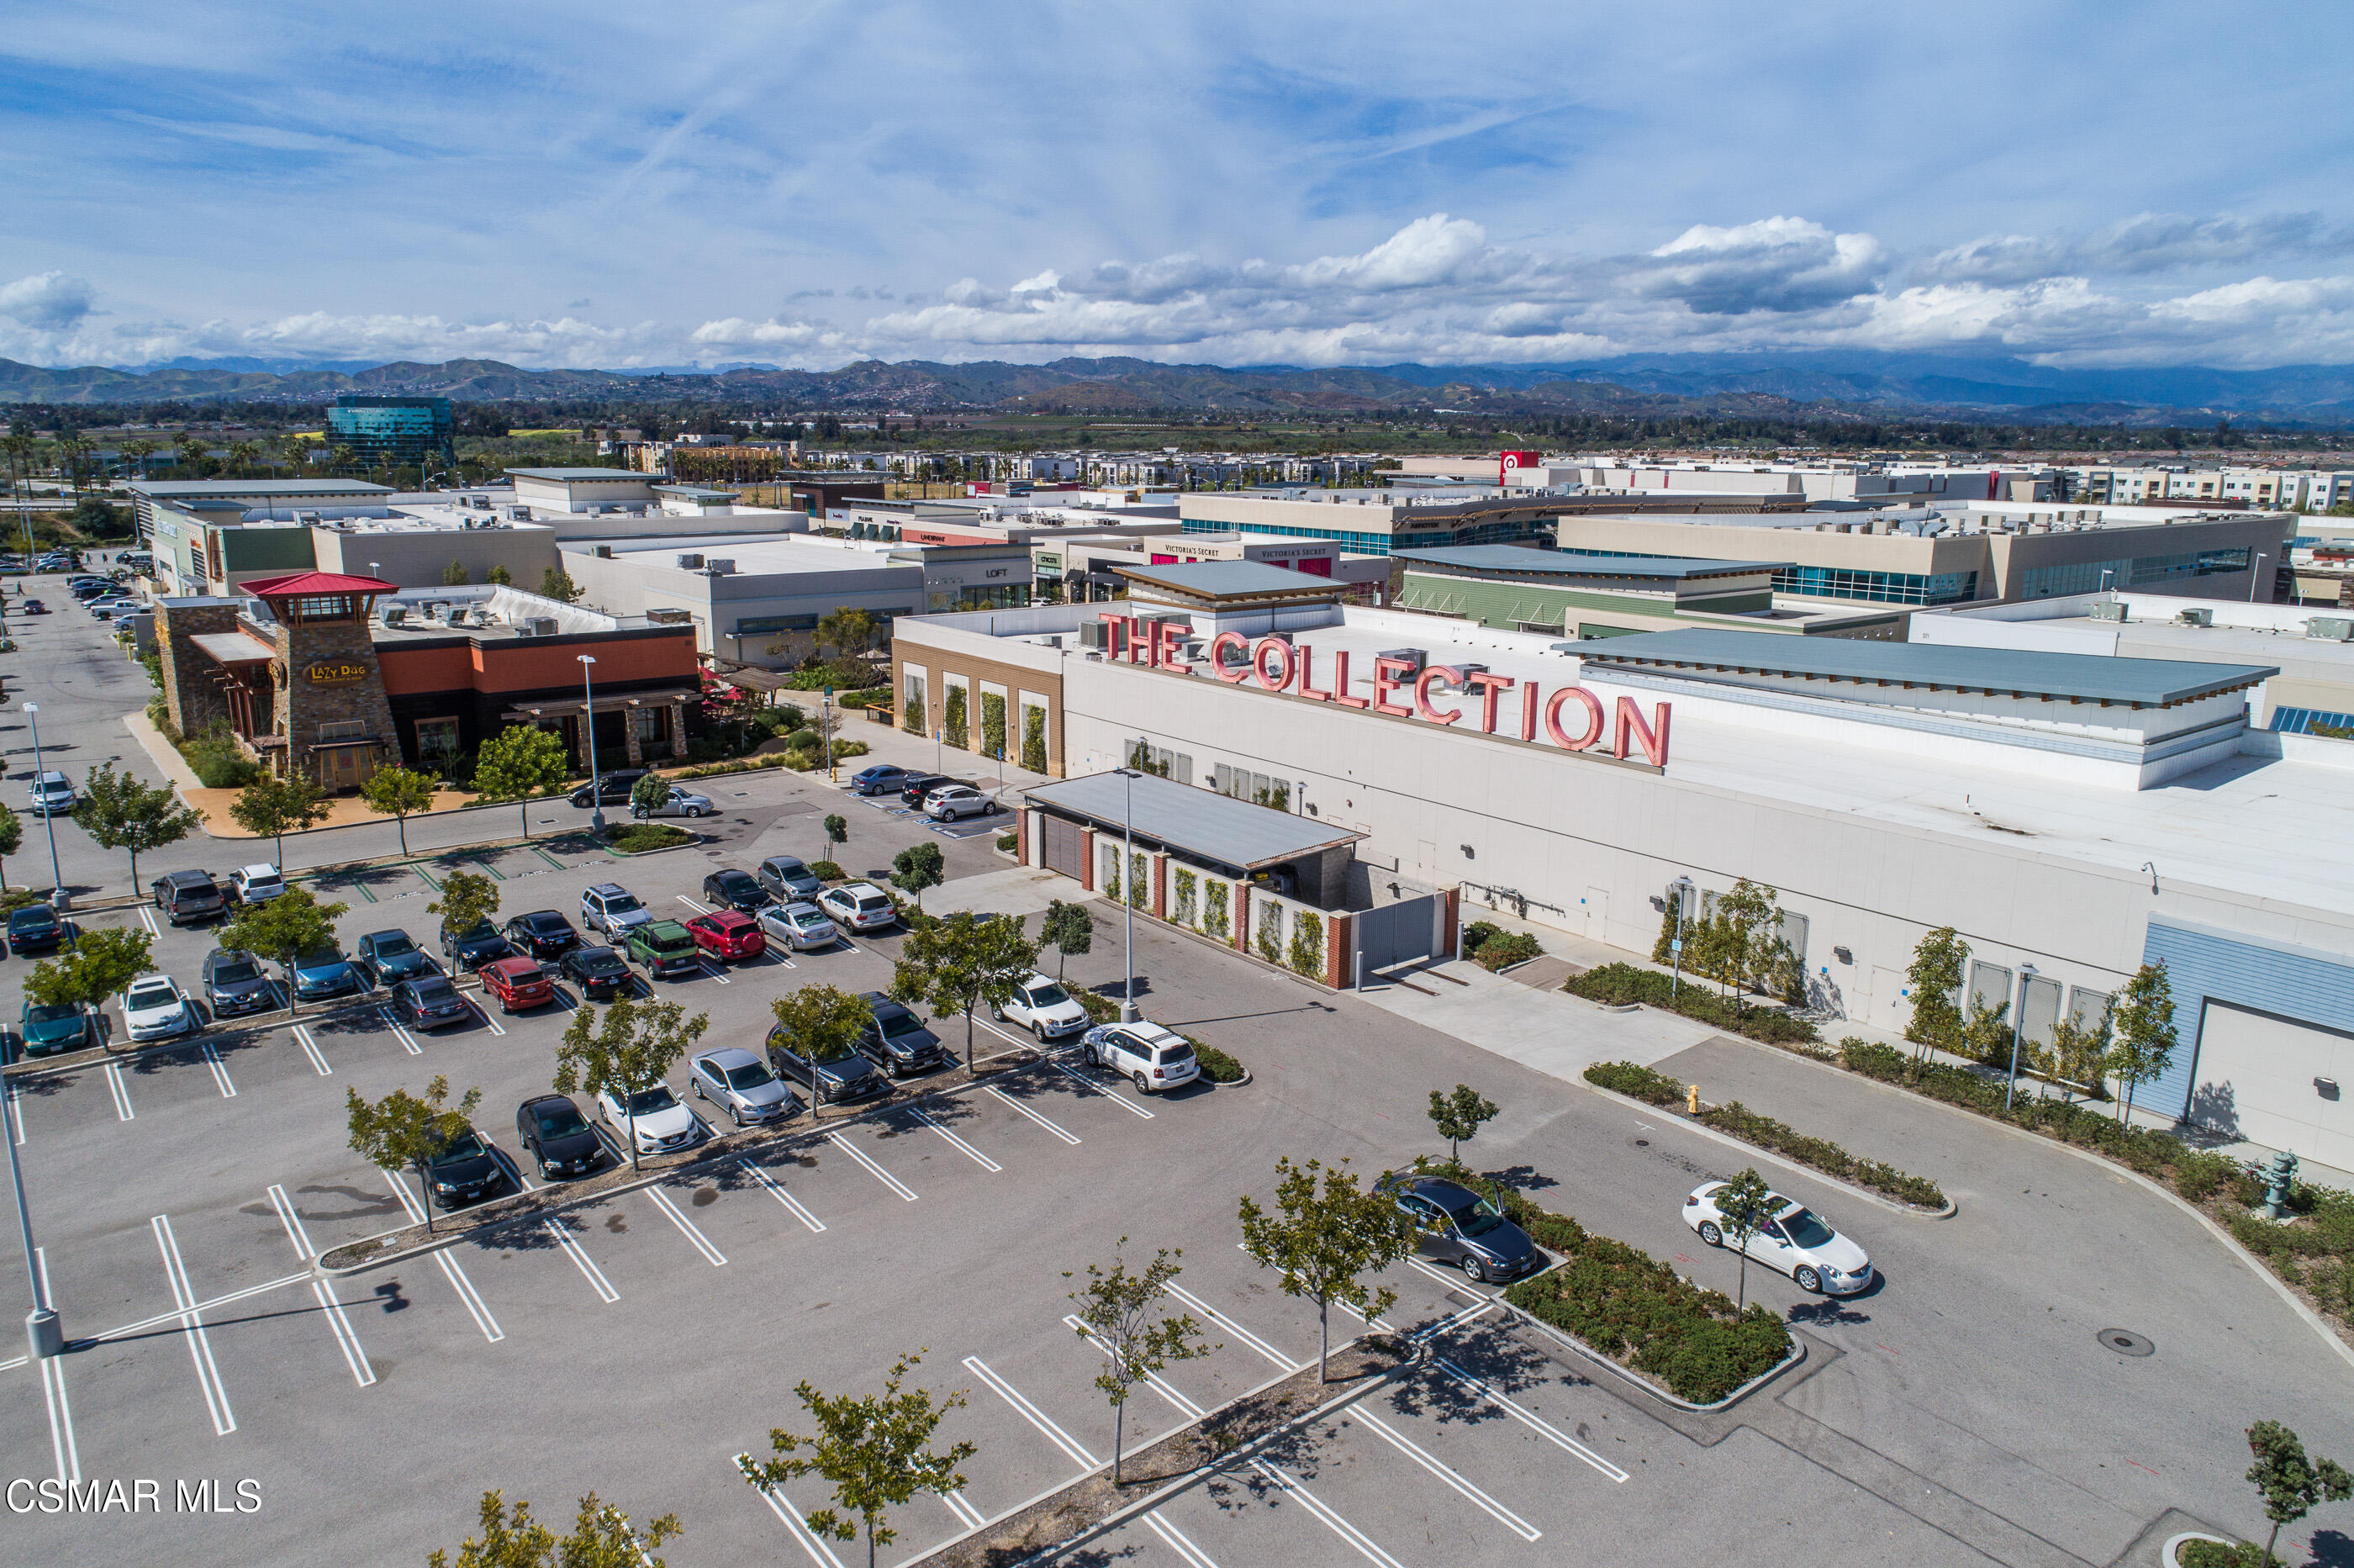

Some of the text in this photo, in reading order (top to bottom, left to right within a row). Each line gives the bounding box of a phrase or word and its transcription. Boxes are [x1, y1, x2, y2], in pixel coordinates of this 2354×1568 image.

[1165, 544, 1219, 557] VICTORIA'S SECRET
[1262, 549, 1301, 558] VICTORIA'S
[986, 568, 1008, 578] LOFT
[311, 665, 366, 679] LAZY DOG
[1099, 613, 1671, 767] THE COLLECTION
